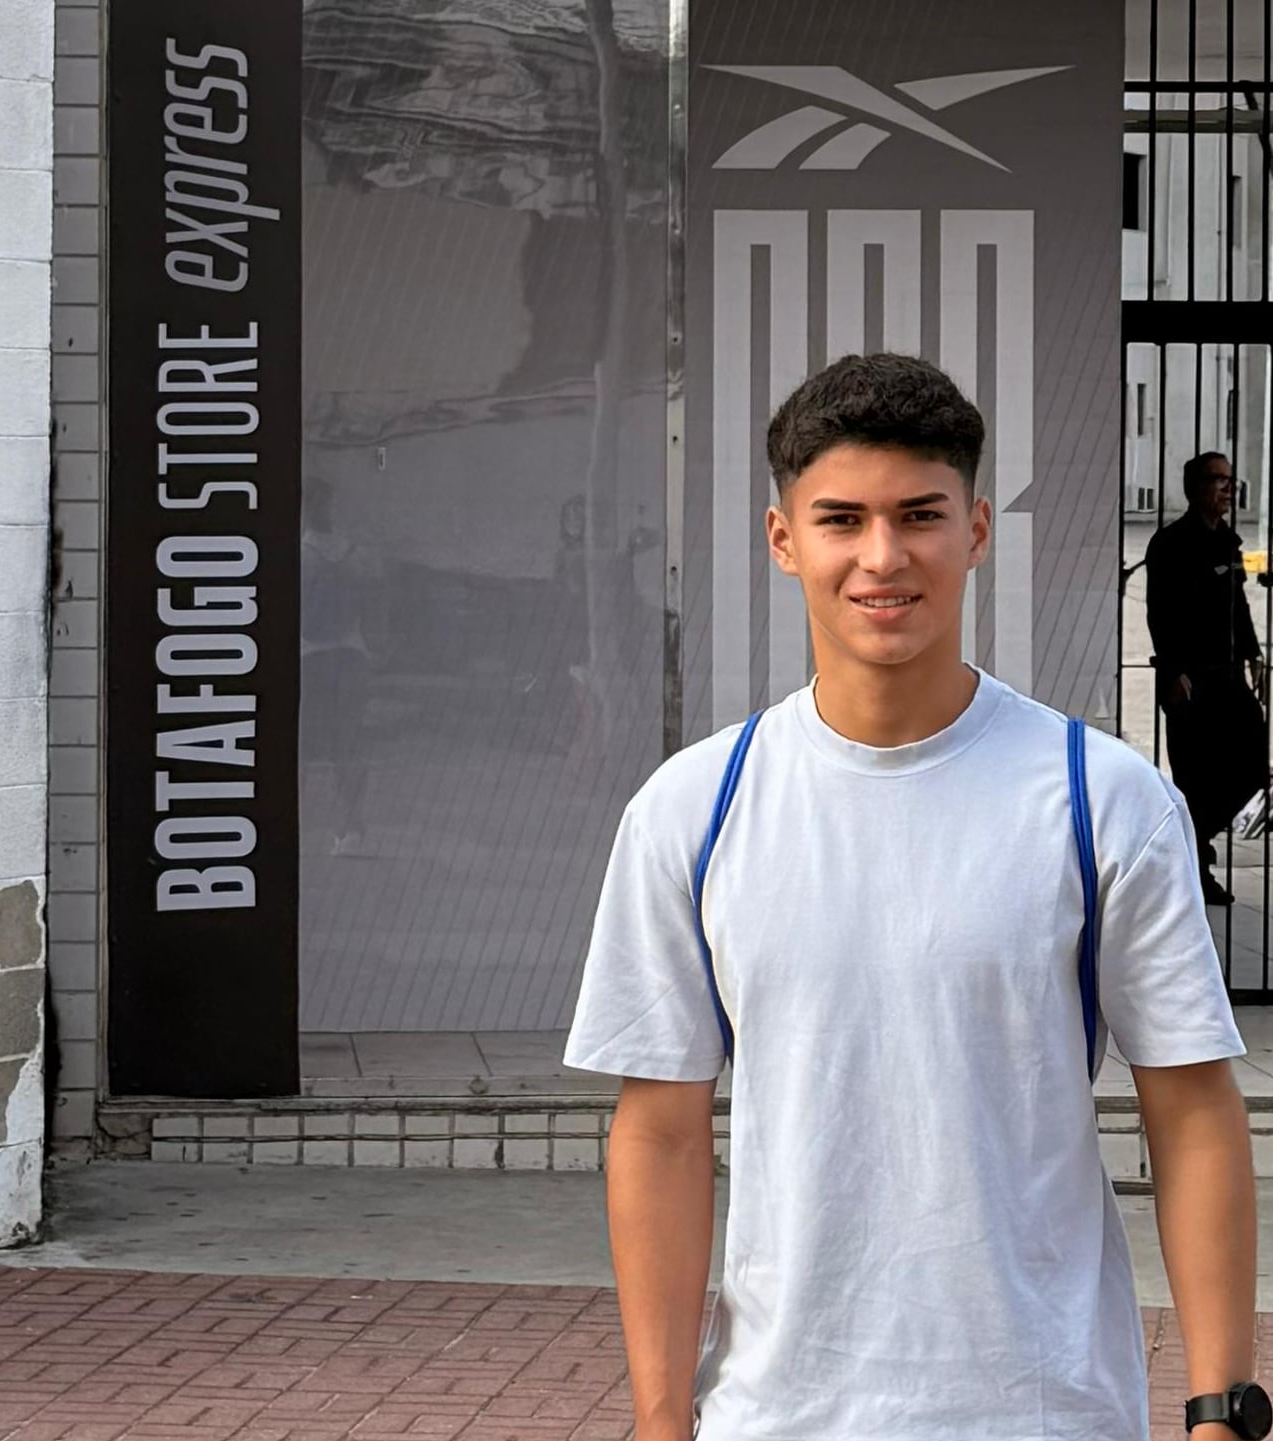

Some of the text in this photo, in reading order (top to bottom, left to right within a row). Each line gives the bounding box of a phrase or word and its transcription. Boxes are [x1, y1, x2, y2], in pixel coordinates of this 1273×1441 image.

[155, 37, 280, 913] BOTAFOGO STORE express
